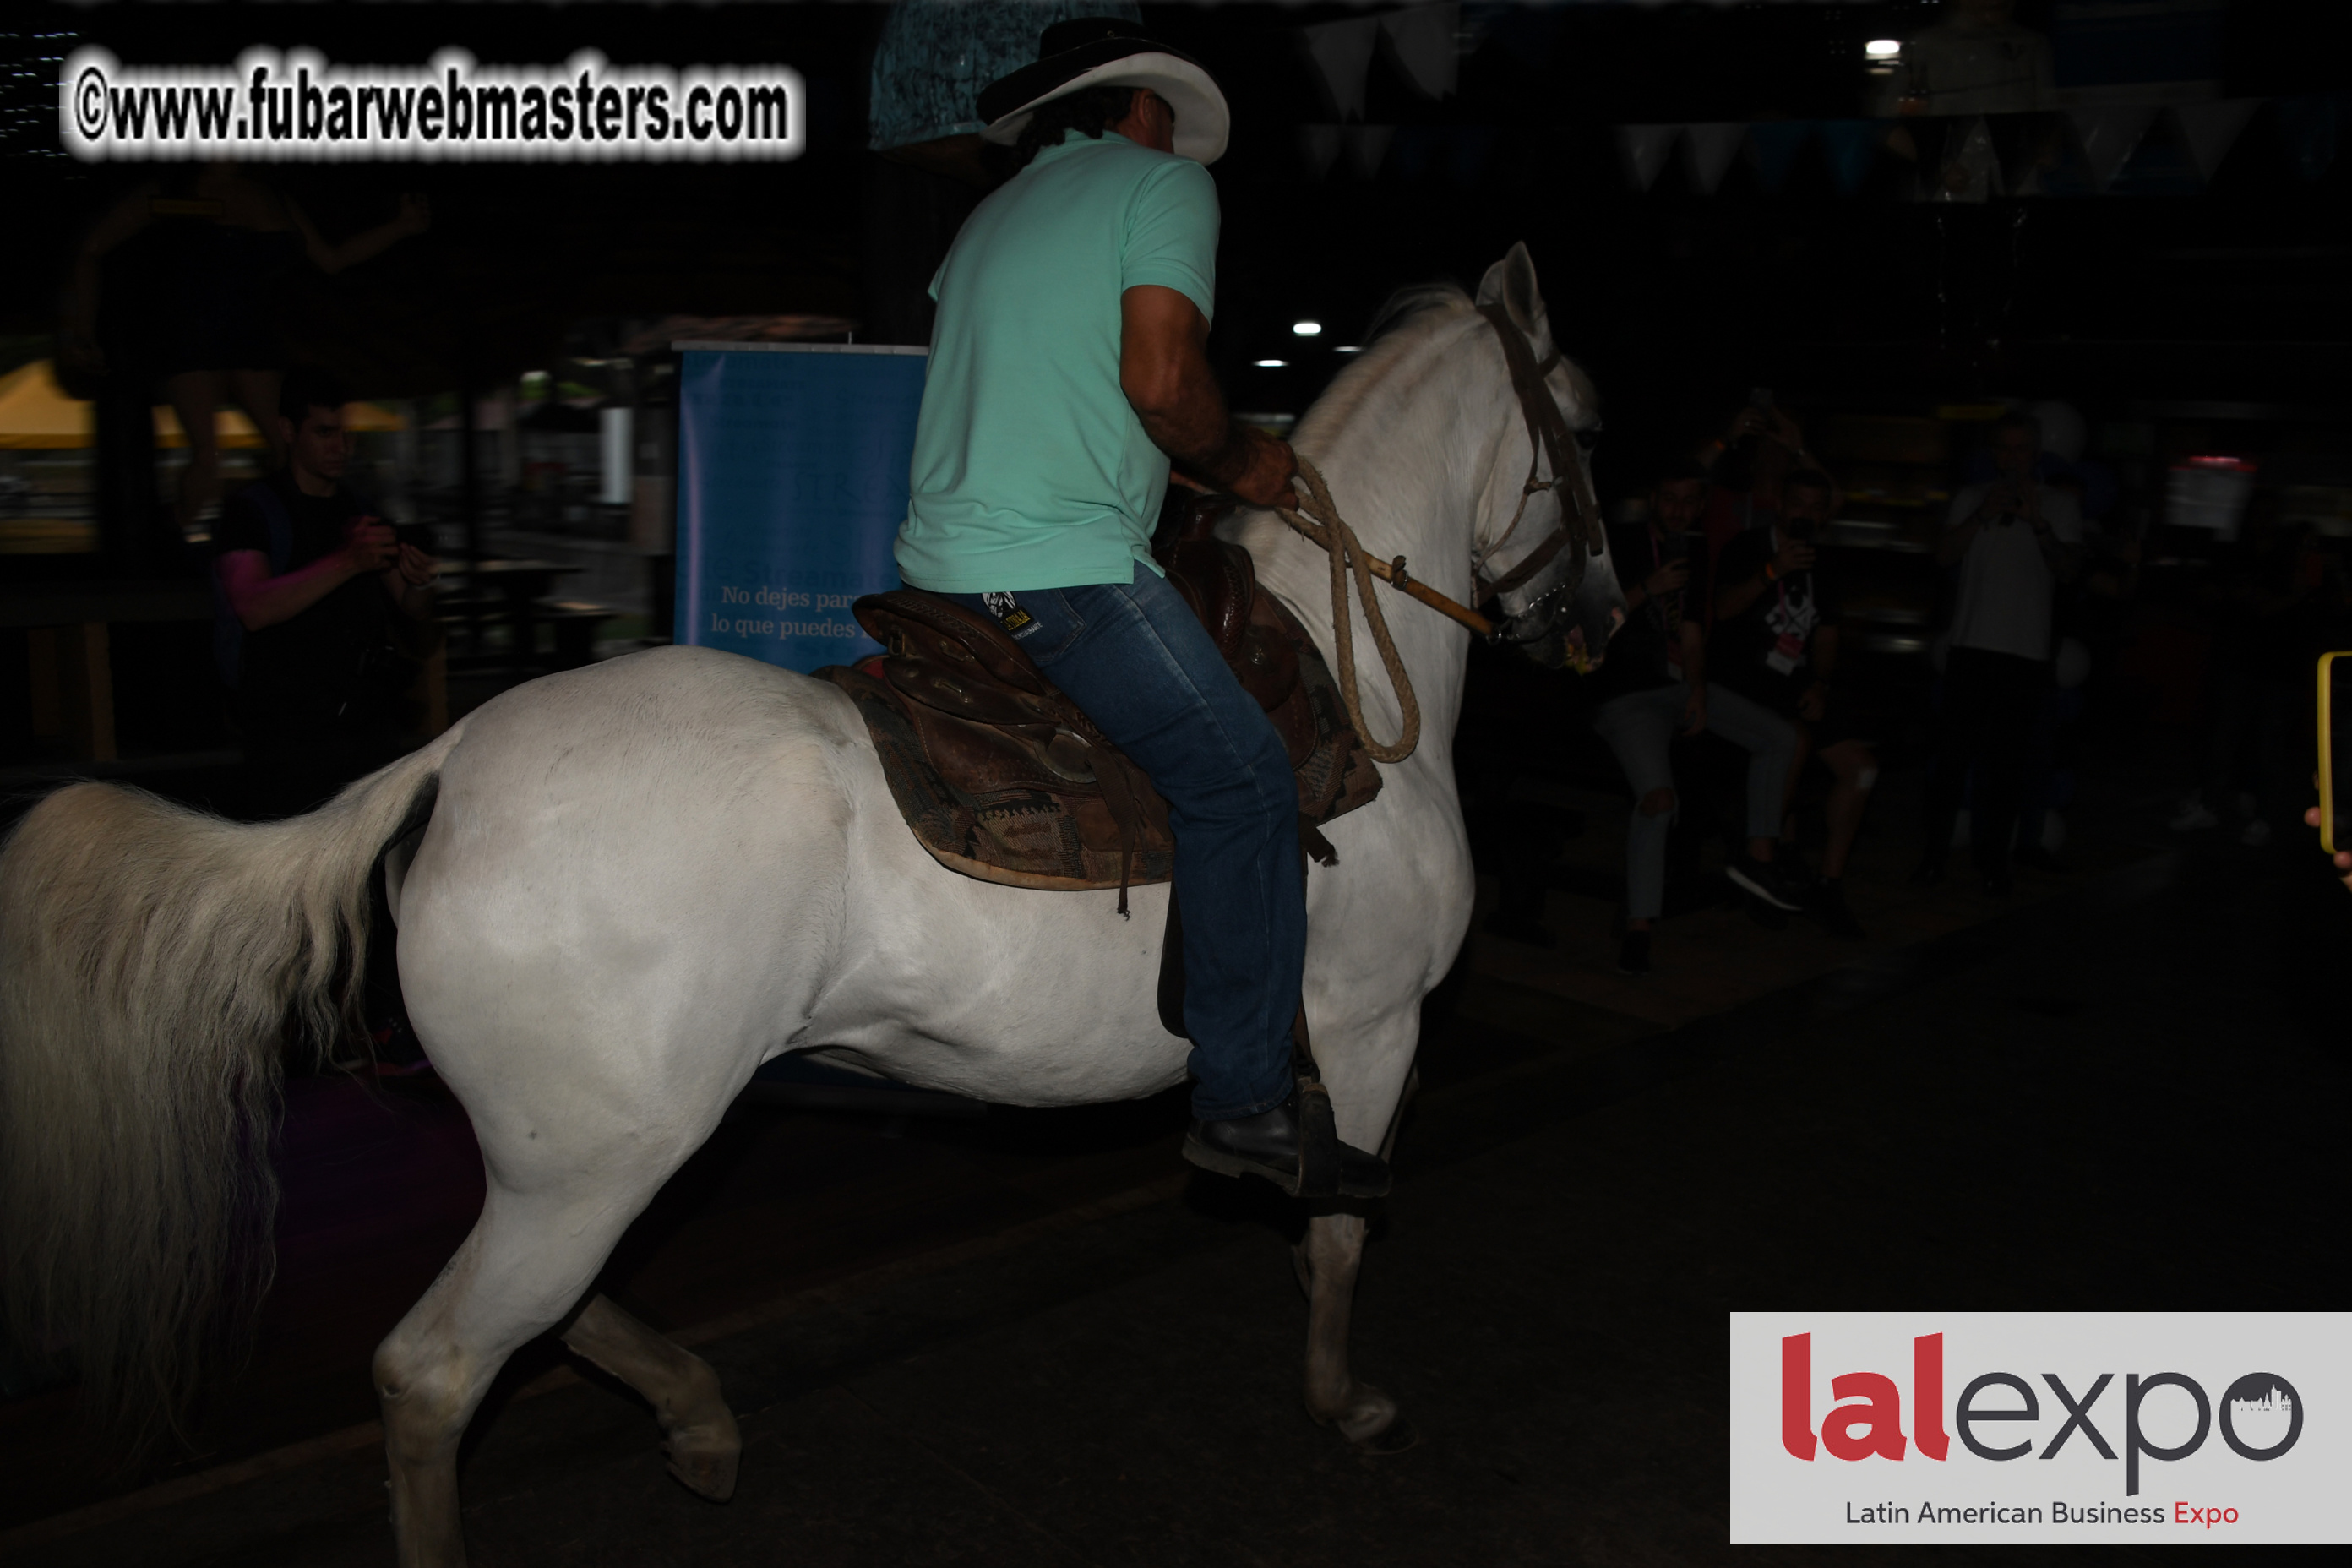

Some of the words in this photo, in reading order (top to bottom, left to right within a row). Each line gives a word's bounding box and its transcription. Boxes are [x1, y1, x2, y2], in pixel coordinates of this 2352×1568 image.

[721, 585, 750, 604] No
[755, 586, 811, 611] dejes
[710, 612, 730, 632] lo
[735, 618, 774, 638] que
[779, 617, 856, 640] puedes
